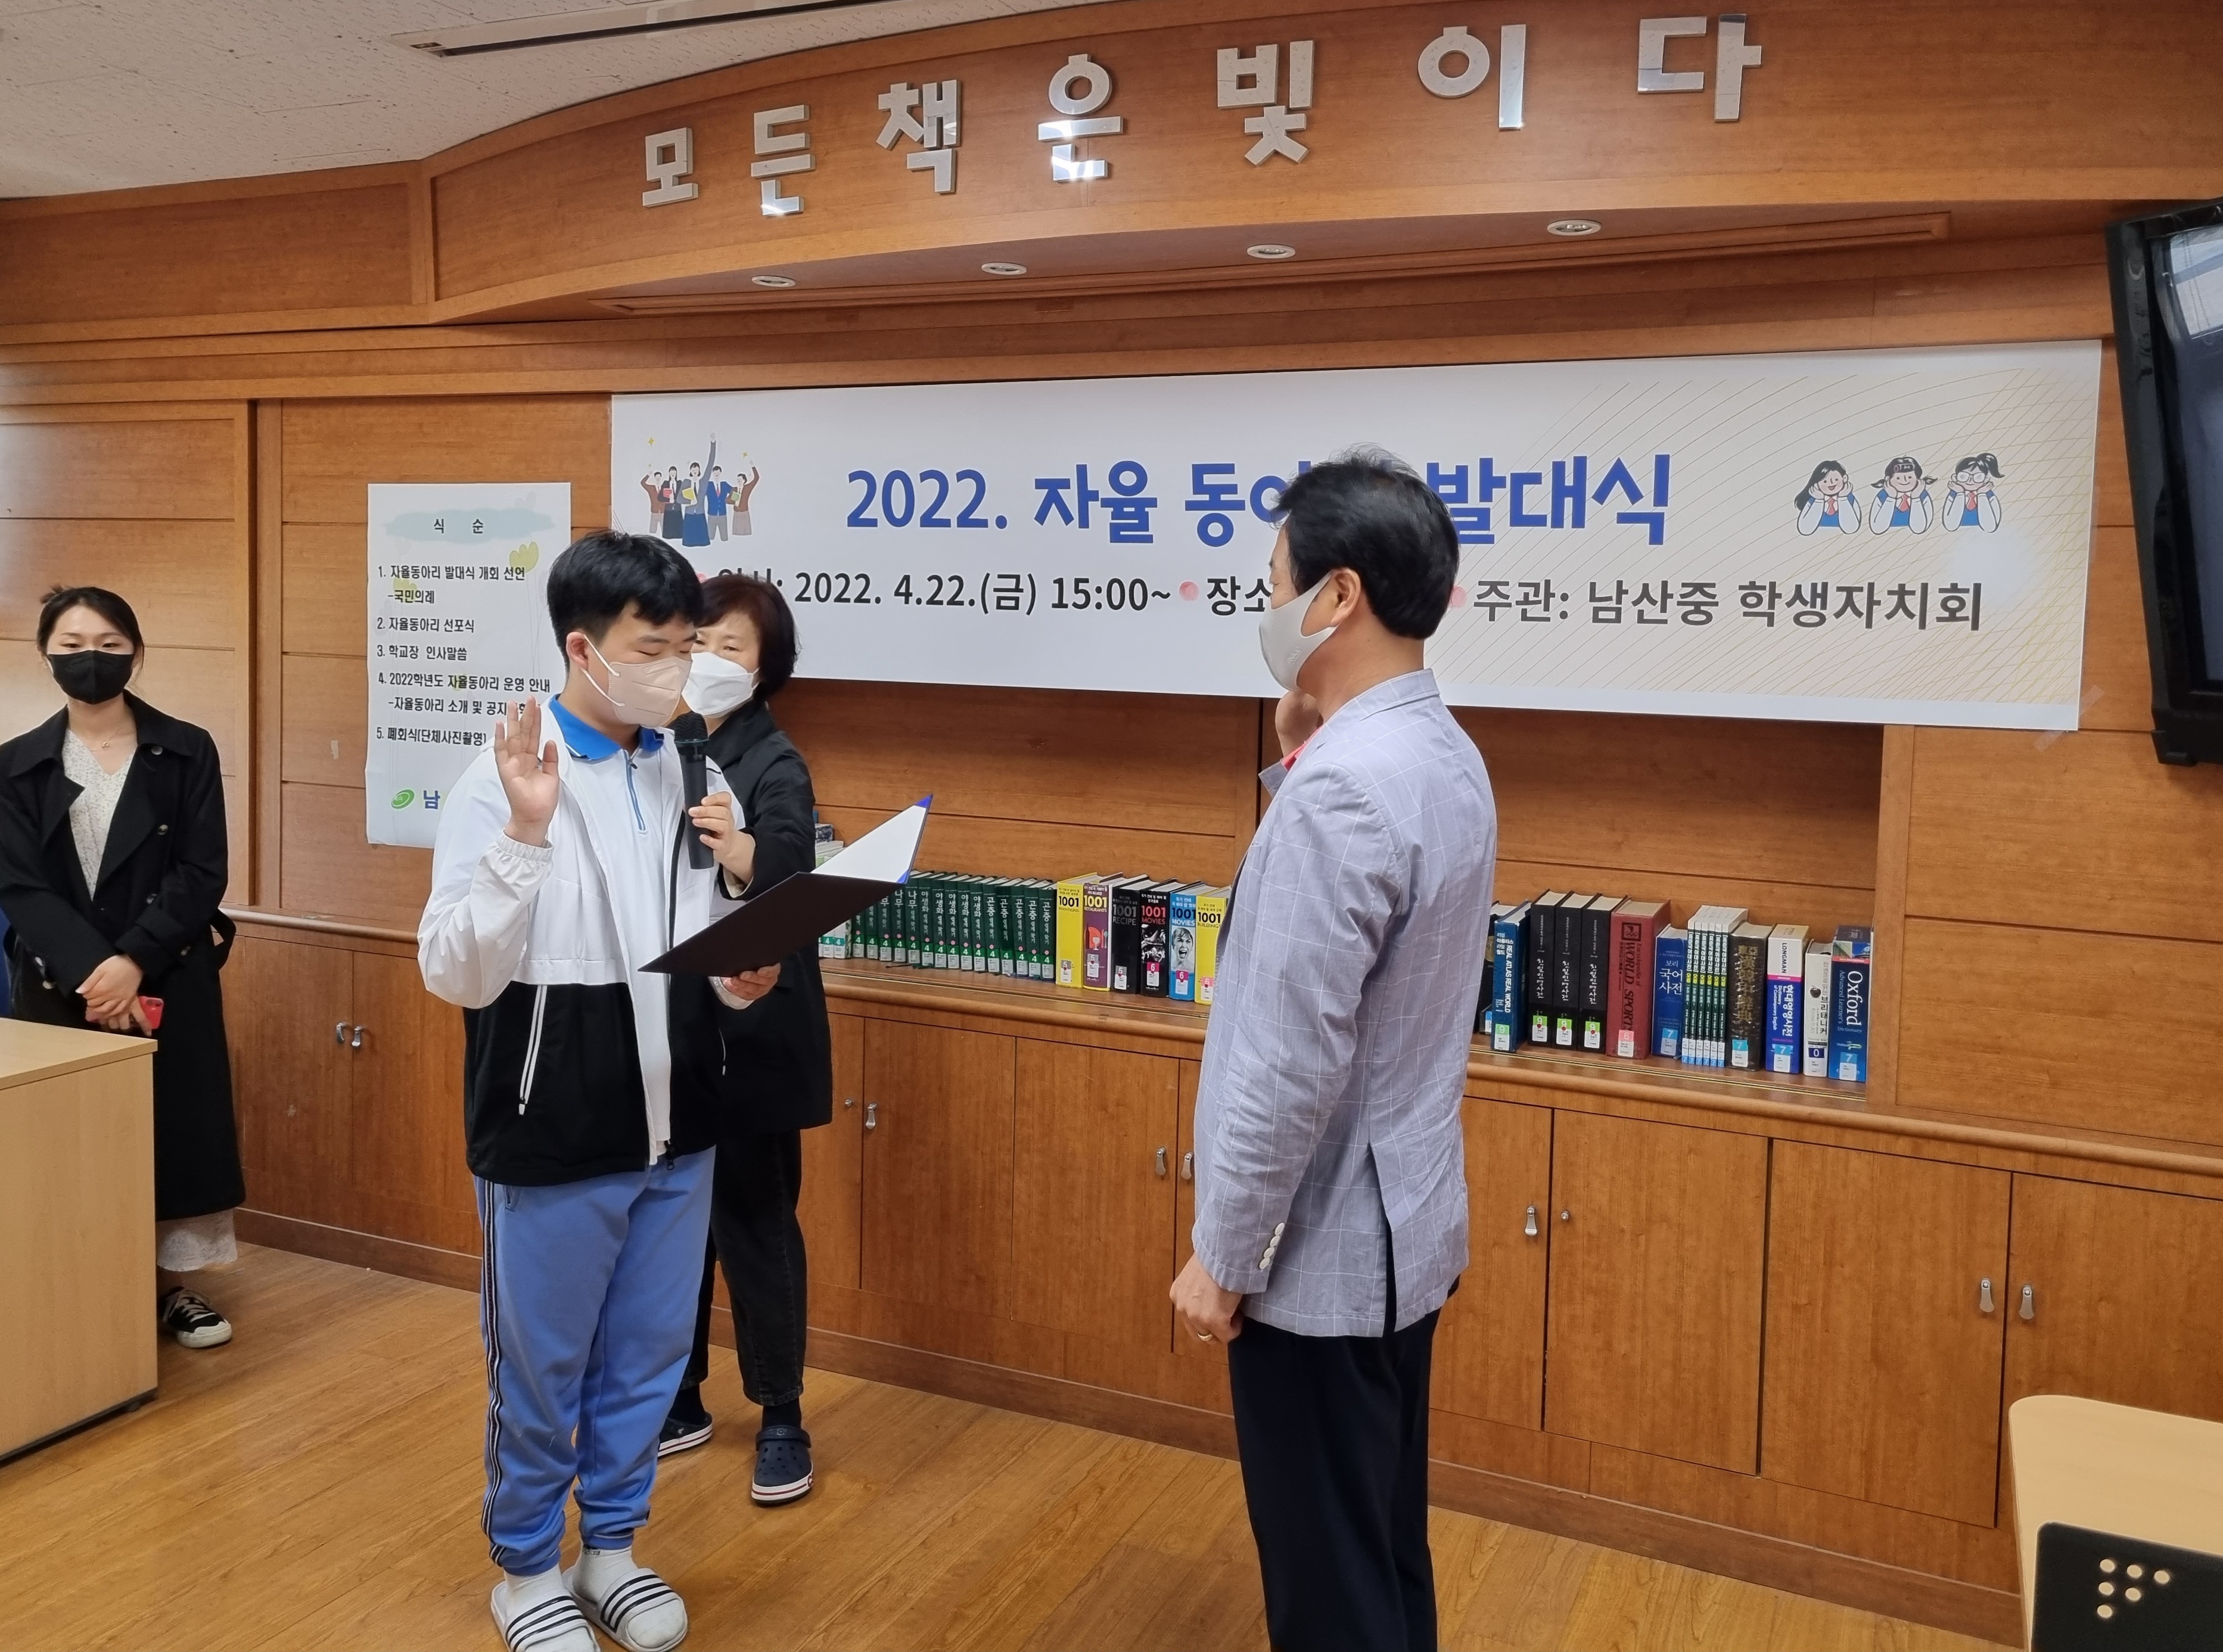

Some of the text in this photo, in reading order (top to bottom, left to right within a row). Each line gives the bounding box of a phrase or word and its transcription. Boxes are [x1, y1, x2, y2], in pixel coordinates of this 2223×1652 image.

[845, 468, 1009, 529] 2022.
[1033, 461, 1158, 545] 자율
[1426, 453, 1670, 546] 발대식
[434, 518, 484, 535] 식 순
[378, 565, 526, 581] 1. 자율동아리 발대식 개회 선언
[388, 589, 435, 604] -국민의례
[795, 573, 882, 606] 2022.
[893, 573, 1037, 620] 4.22.(금)
[1051, 575, 1171, 612] 15:00~
[1473, 578, 1982, 631] 주관: 남산중 학생자치회
[377, 617, 474, 633] 2. 자율동아리 선포식
[377, 645, 468, 661] 3. 학교장 인사말씀
[378, 672, 551, 693] 4. 2022학년도 자율동아리 운영 안내
[388, 696, 444, 713] -자율동아리
[448, 699, 468, 714] 소개
[472, 701, 481, 715] 및
[377, 727, 384, 739] 5.
[881, 896, 889, 907] 무
[894, 889, 903, 907] 나무
[908, 891, 917, 909] 나무
[1059, 895, 1079, 907] 1001
[1084, 895, 1107, 908] 1001
[986, 897, 995, 916] 곤충
[1000, 899, 1008, 918] 곤충
[1015, 899, 1024, 919] 곤충
[1028, 901, 1037, 920] 곤충
[1042, 902, 1051, 922] 곤충
[1112, 904, 1136, 918] 1001
[1141, 906, 1166, 918] 1001
[1172, 907, 1196, 919] 1001
[1112, 916, 1137, 926] RECIPE
[1198, 911, 1221, 923] 1001
[1625, 942, 1635, 984] WORLD
[1659, 968, 1683, 982] 국어
[1658, 982, 1682, 995] 사전
[1848, 970, 1863, 1026] Oxford
[1782, 984, 1794, 1037] 현대영영사전
[1499, 1025, 1505, 1034] 9
[1624, 1032, 1630, 1040] 6
[1780, 1046, 1786, 1054] 7
[1846, 1053, 1852, 1062] 7
